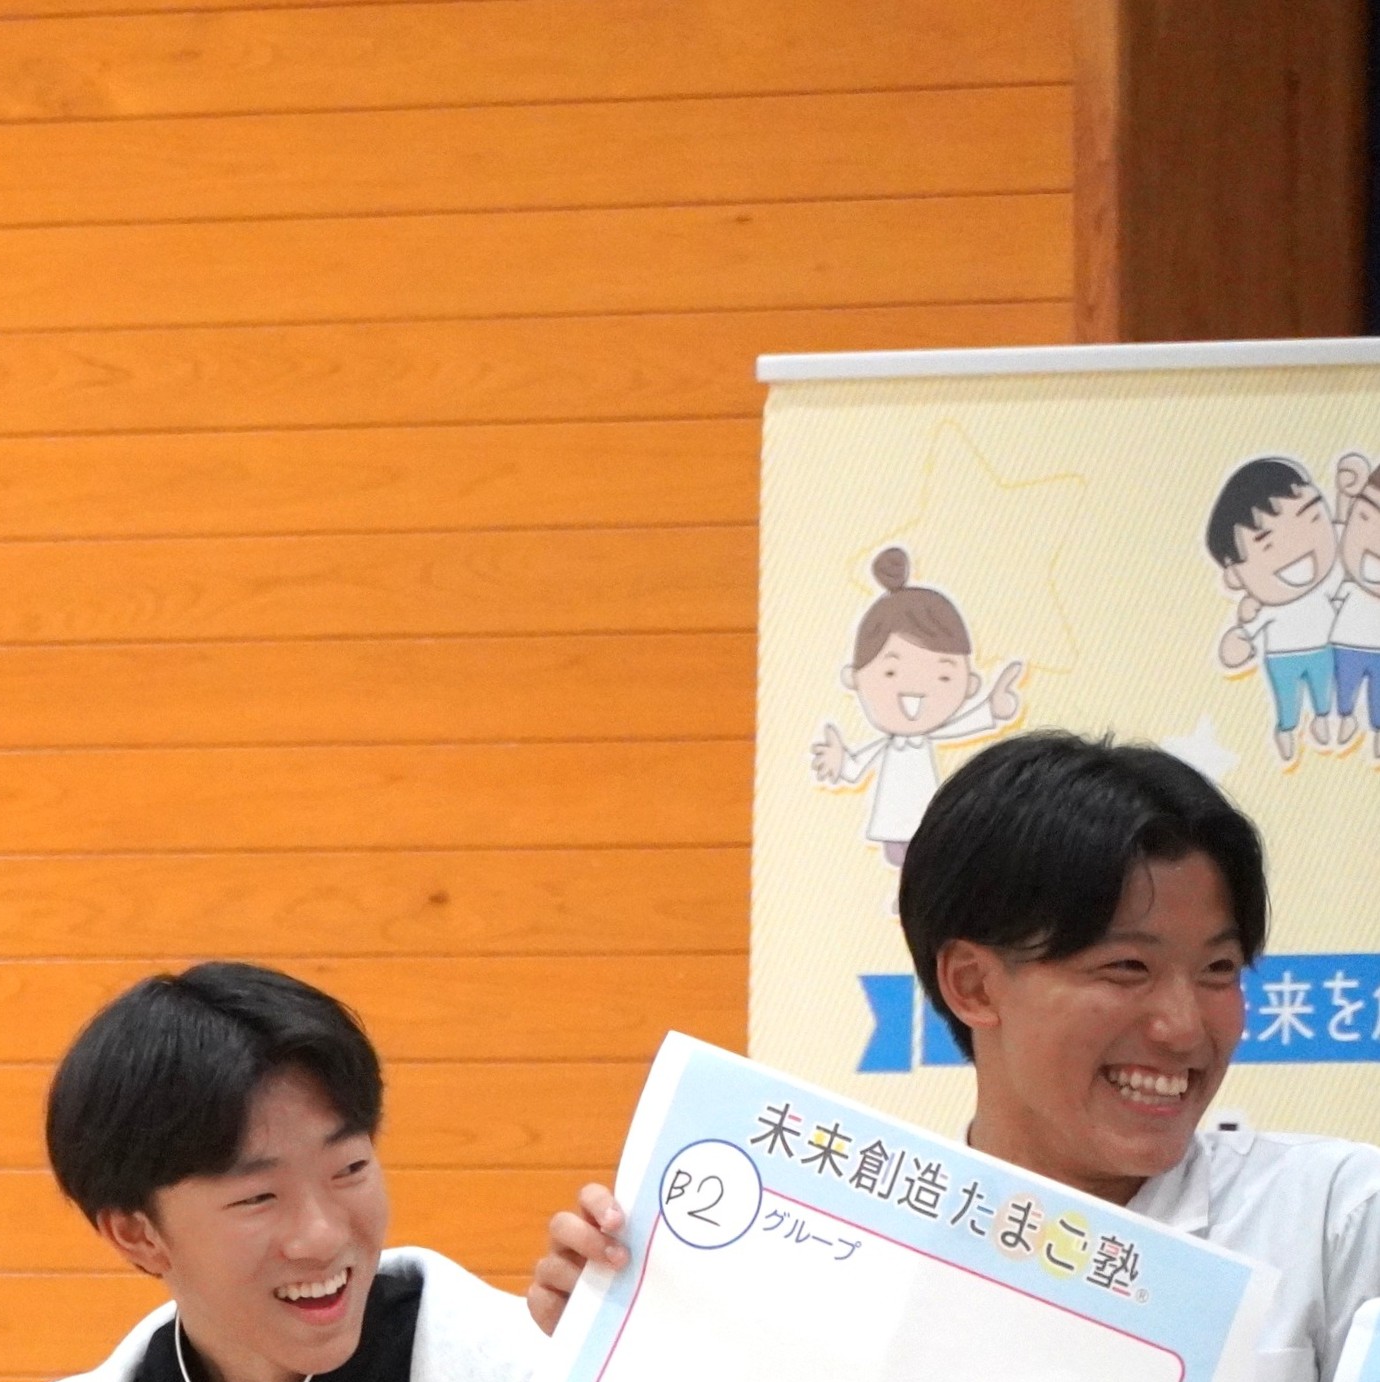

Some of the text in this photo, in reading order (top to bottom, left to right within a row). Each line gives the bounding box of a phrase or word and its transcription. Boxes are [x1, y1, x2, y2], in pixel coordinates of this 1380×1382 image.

[1241, 970, 1380, 1045] 来を
[665, 1170, 863, 1262] B2 グループ
